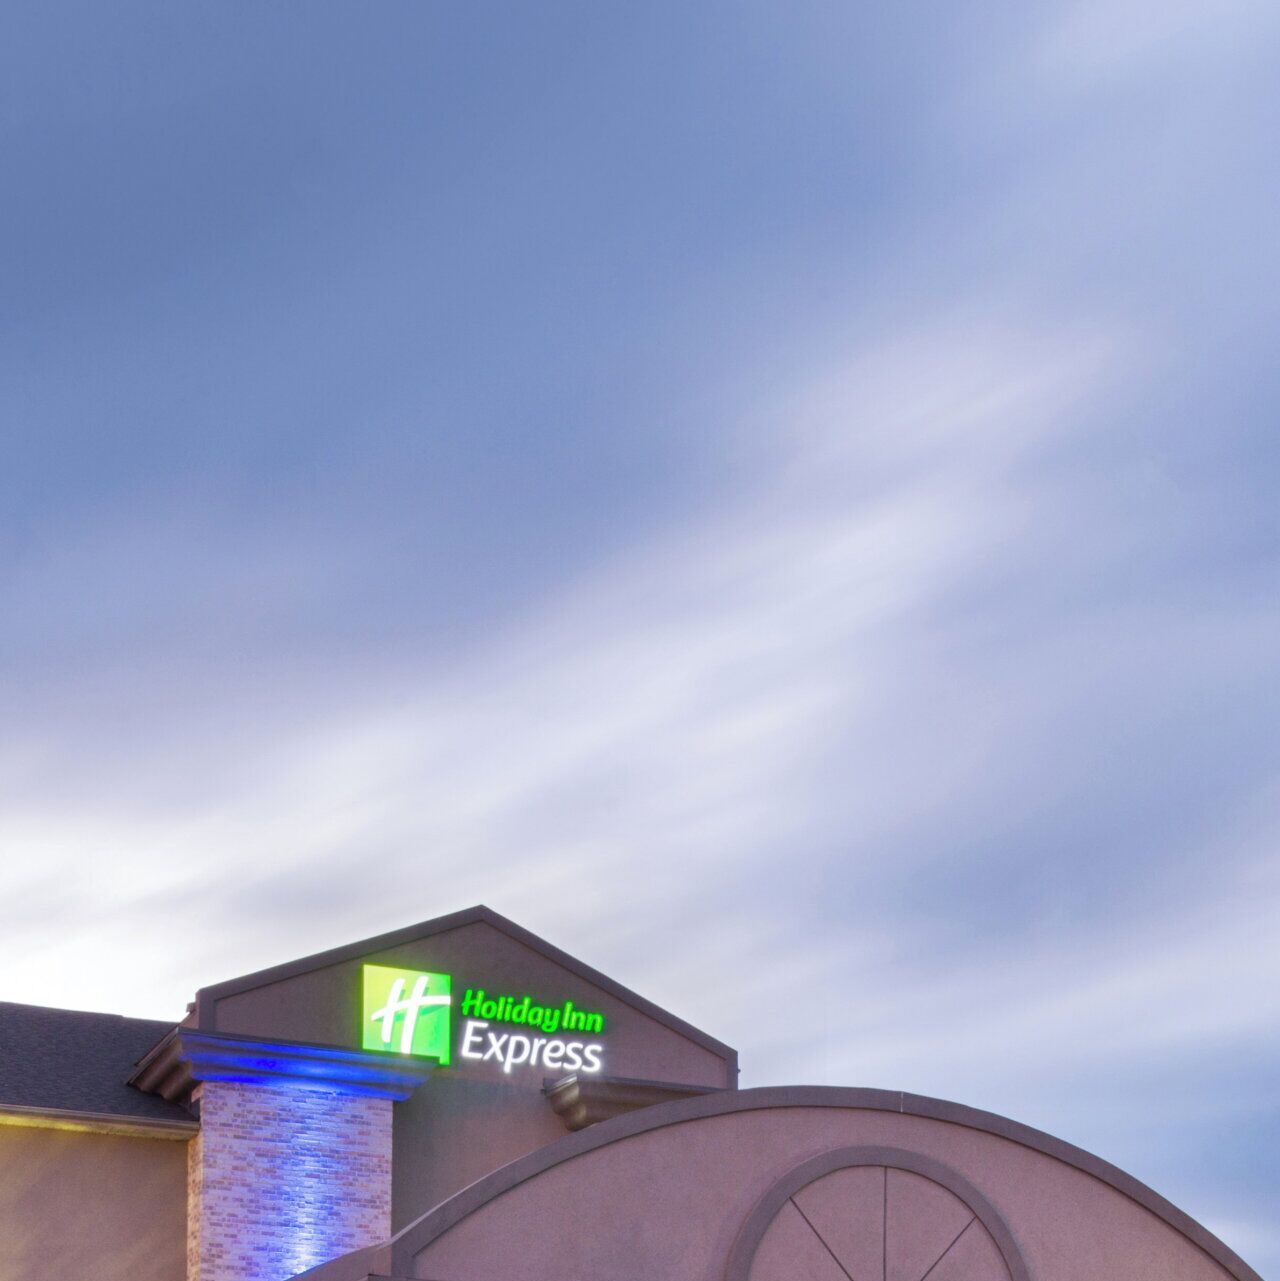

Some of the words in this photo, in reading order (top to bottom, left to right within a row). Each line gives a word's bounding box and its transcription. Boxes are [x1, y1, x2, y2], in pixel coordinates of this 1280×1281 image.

[461, 989, 560, 1032] Holiday
[562, 1001, 604, 1033] Inn
[461, 1020, 602, 1073] Express
